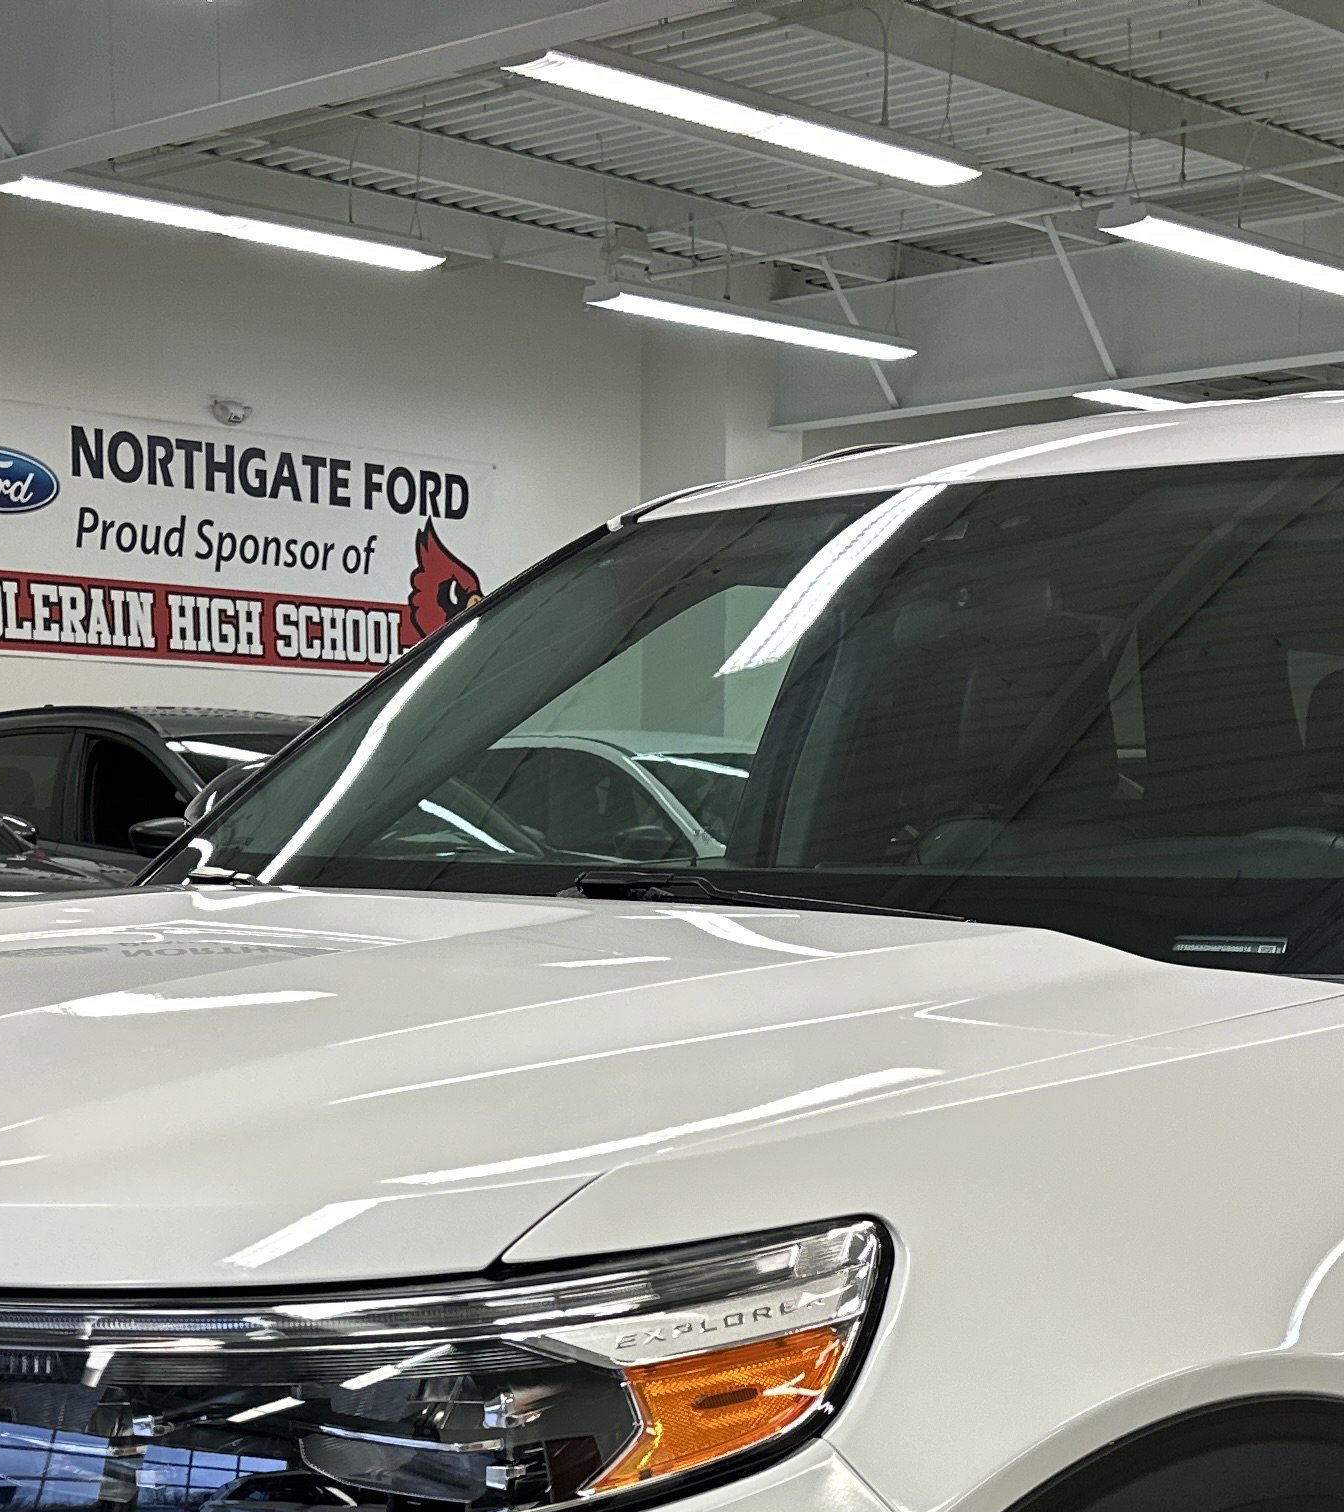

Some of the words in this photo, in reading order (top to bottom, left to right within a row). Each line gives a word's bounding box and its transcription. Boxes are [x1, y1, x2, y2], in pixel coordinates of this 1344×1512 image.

[70, 425, 351, 507] NORTHGATE
[363, 462, 469, 520] FORD
[75, 506, 185, 558] Proud
[195, 518, 334, 573] Sponsor
[342, 535, 377, 574] of
[167, 593, 264, 655] HIGH
[273, 604, 409, 666] SCHOOL
[616, 1296, 825, 1349] EXPLORER
